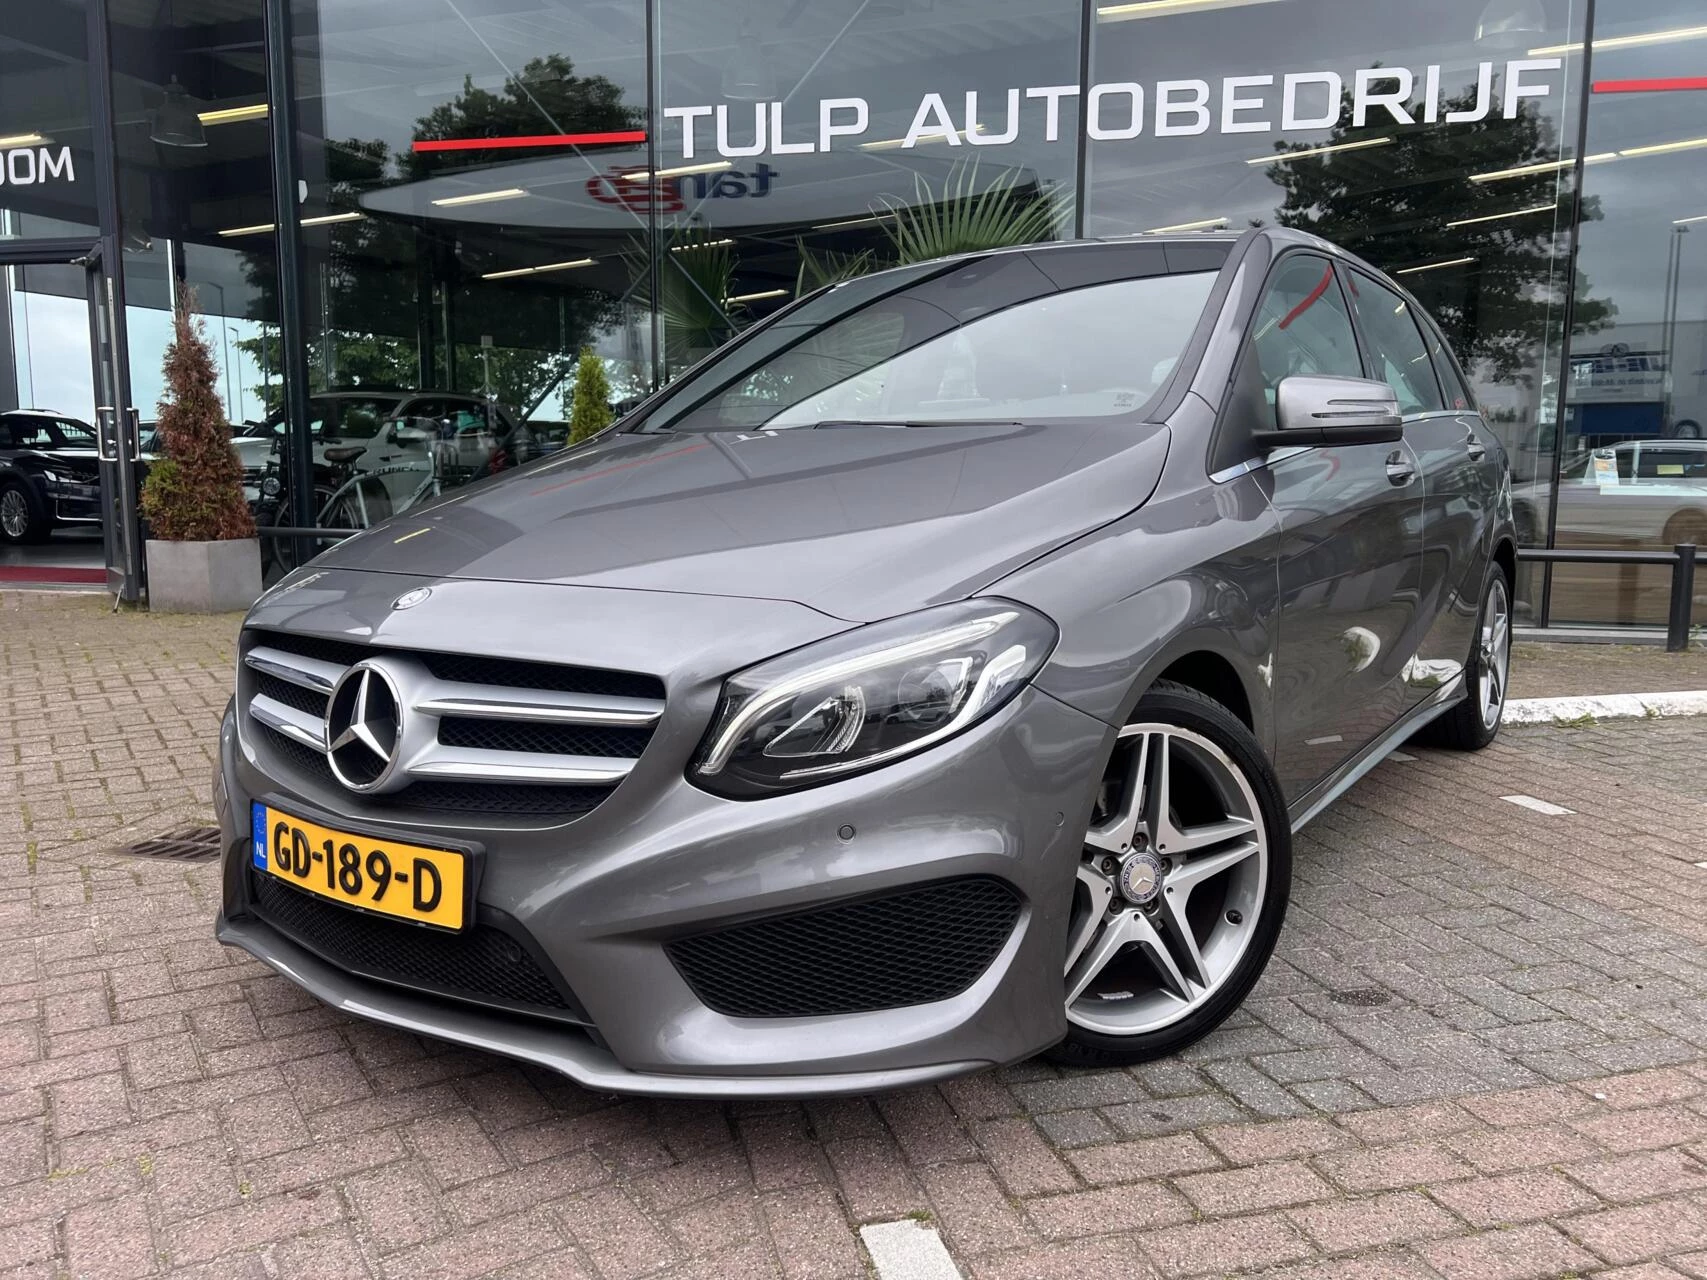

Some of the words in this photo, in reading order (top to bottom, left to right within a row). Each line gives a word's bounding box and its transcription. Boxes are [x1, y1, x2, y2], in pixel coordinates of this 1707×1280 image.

[663, 97, 869, 159] TULP
[901, 58, 1562, 149] AUTOBEDRIJF
[0, 146, 75, 186] OM
[255, 841, 267, 859] NL
[273, 821, 443, 913] GD-189-D
